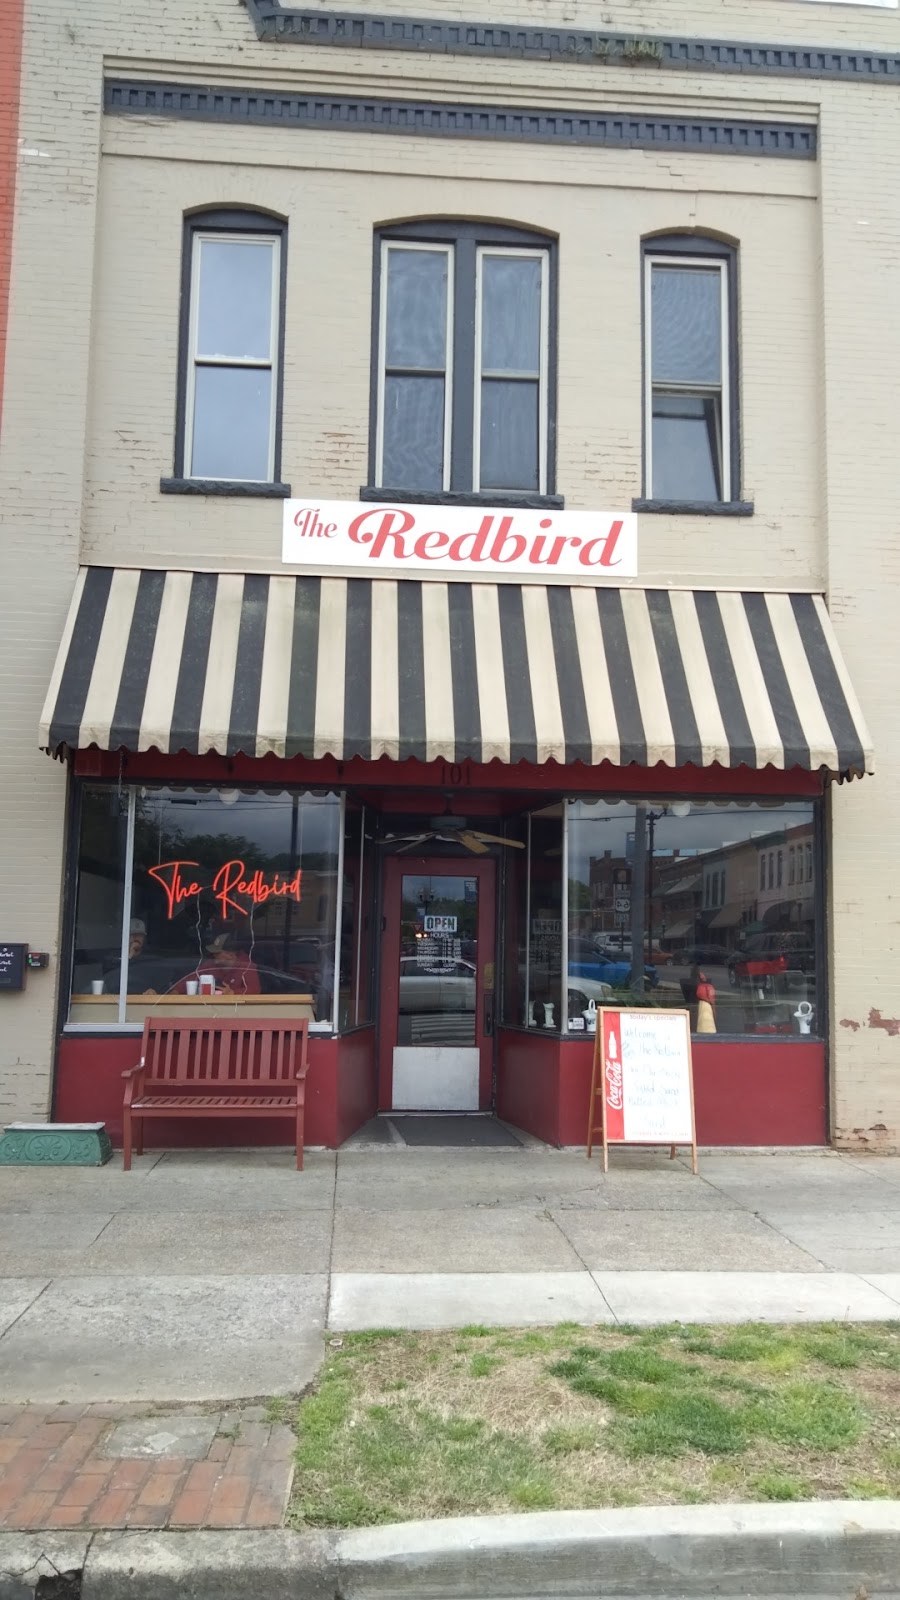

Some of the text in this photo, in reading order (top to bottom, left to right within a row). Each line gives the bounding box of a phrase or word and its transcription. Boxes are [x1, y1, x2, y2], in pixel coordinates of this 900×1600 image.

[293, 508, 623, 567] The Redbird
[442, 765, 470, 785] 101
[148, 860, 302, 919] The Redbird
[427, 917, 455, 930] OPEN
